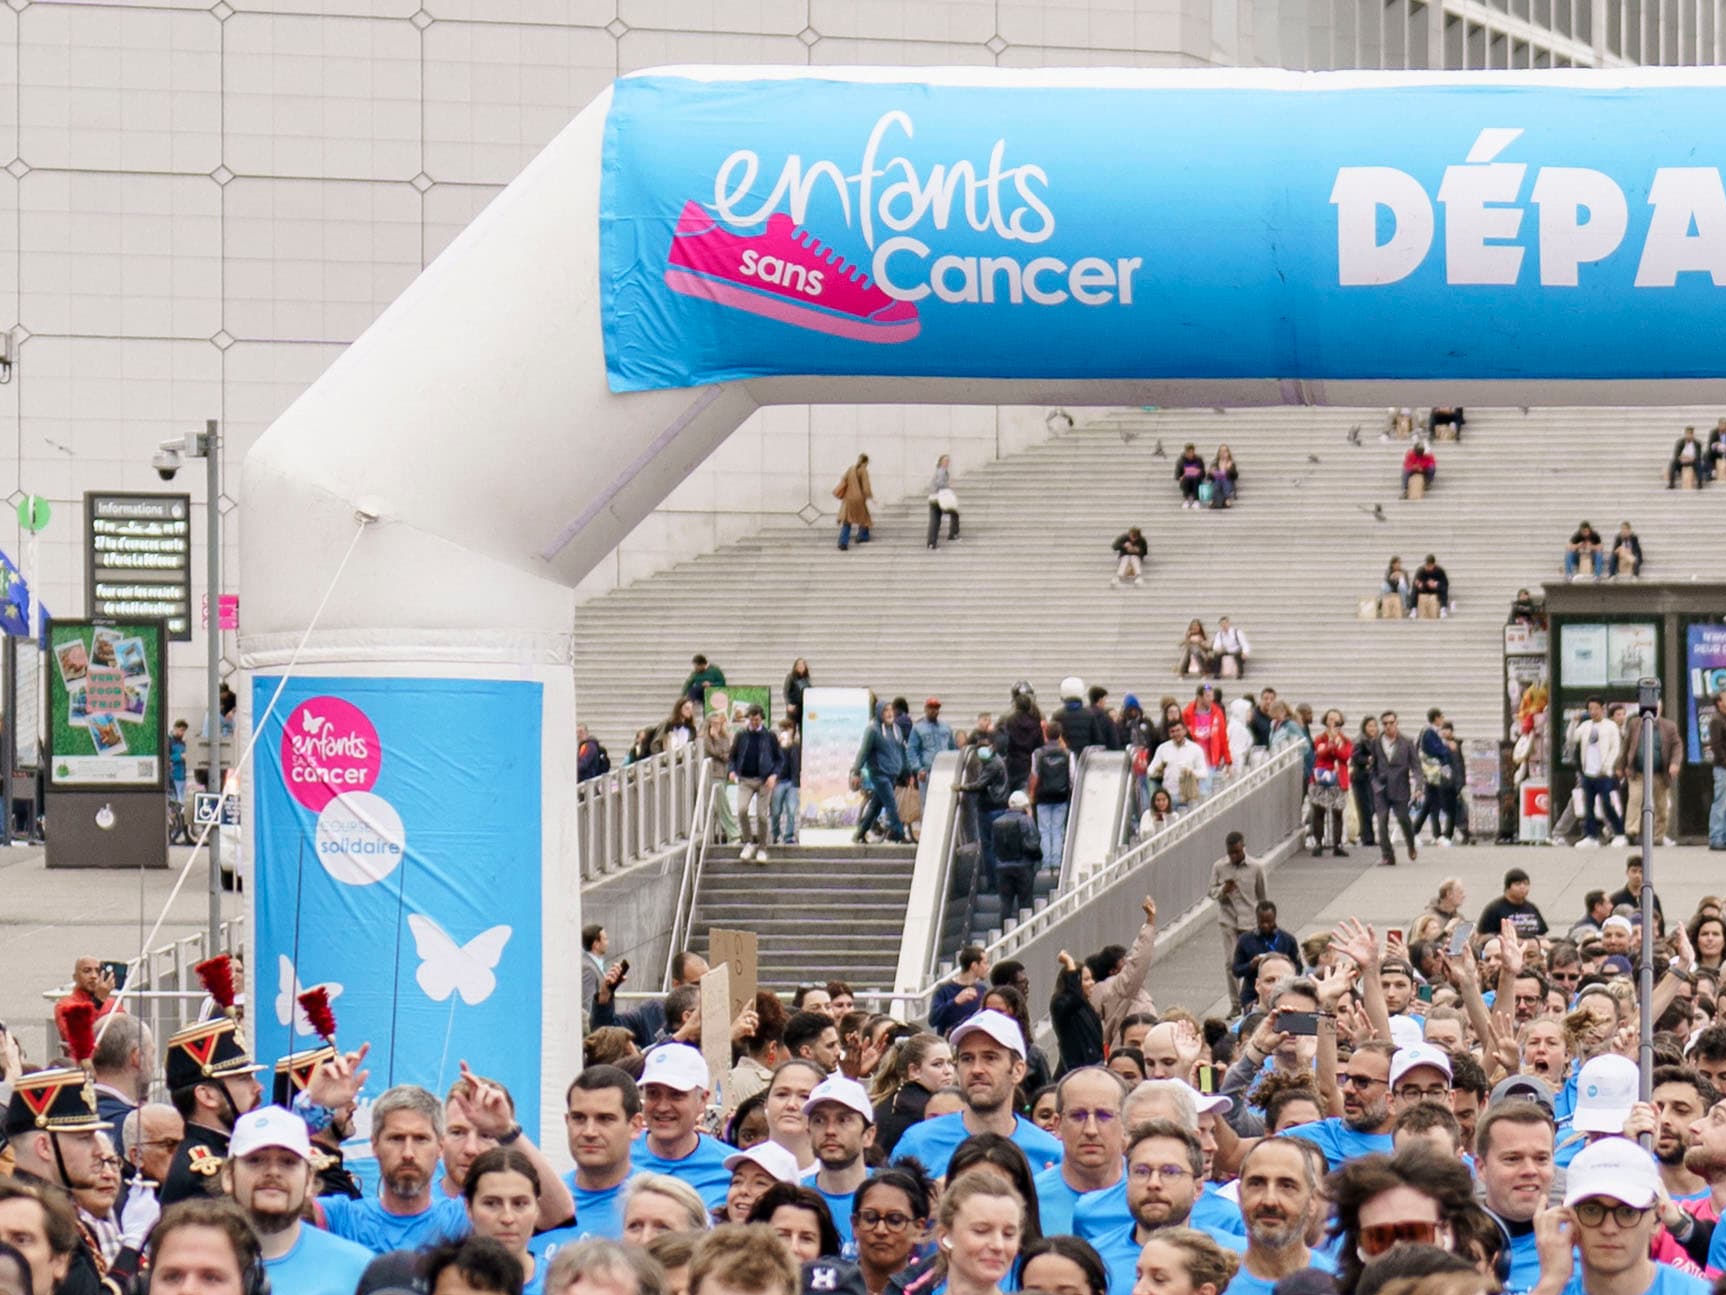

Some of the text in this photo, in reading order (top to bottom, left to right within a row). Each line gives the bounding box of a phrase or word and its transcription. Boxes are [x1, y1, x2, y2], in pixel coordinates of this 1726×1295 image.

[704, 110, 1056, 252] enfants
[739, 247, 824, 297] sans
[871, 236, 1143, 307] Cancer
[98, 502, 163, 514] Informations
[292, 722, 368, 761] enfants
[292, 755, 316, 767] SAS
[291, 767, 368, 784] cancer
[321, 838, 400, 854] solidaire
